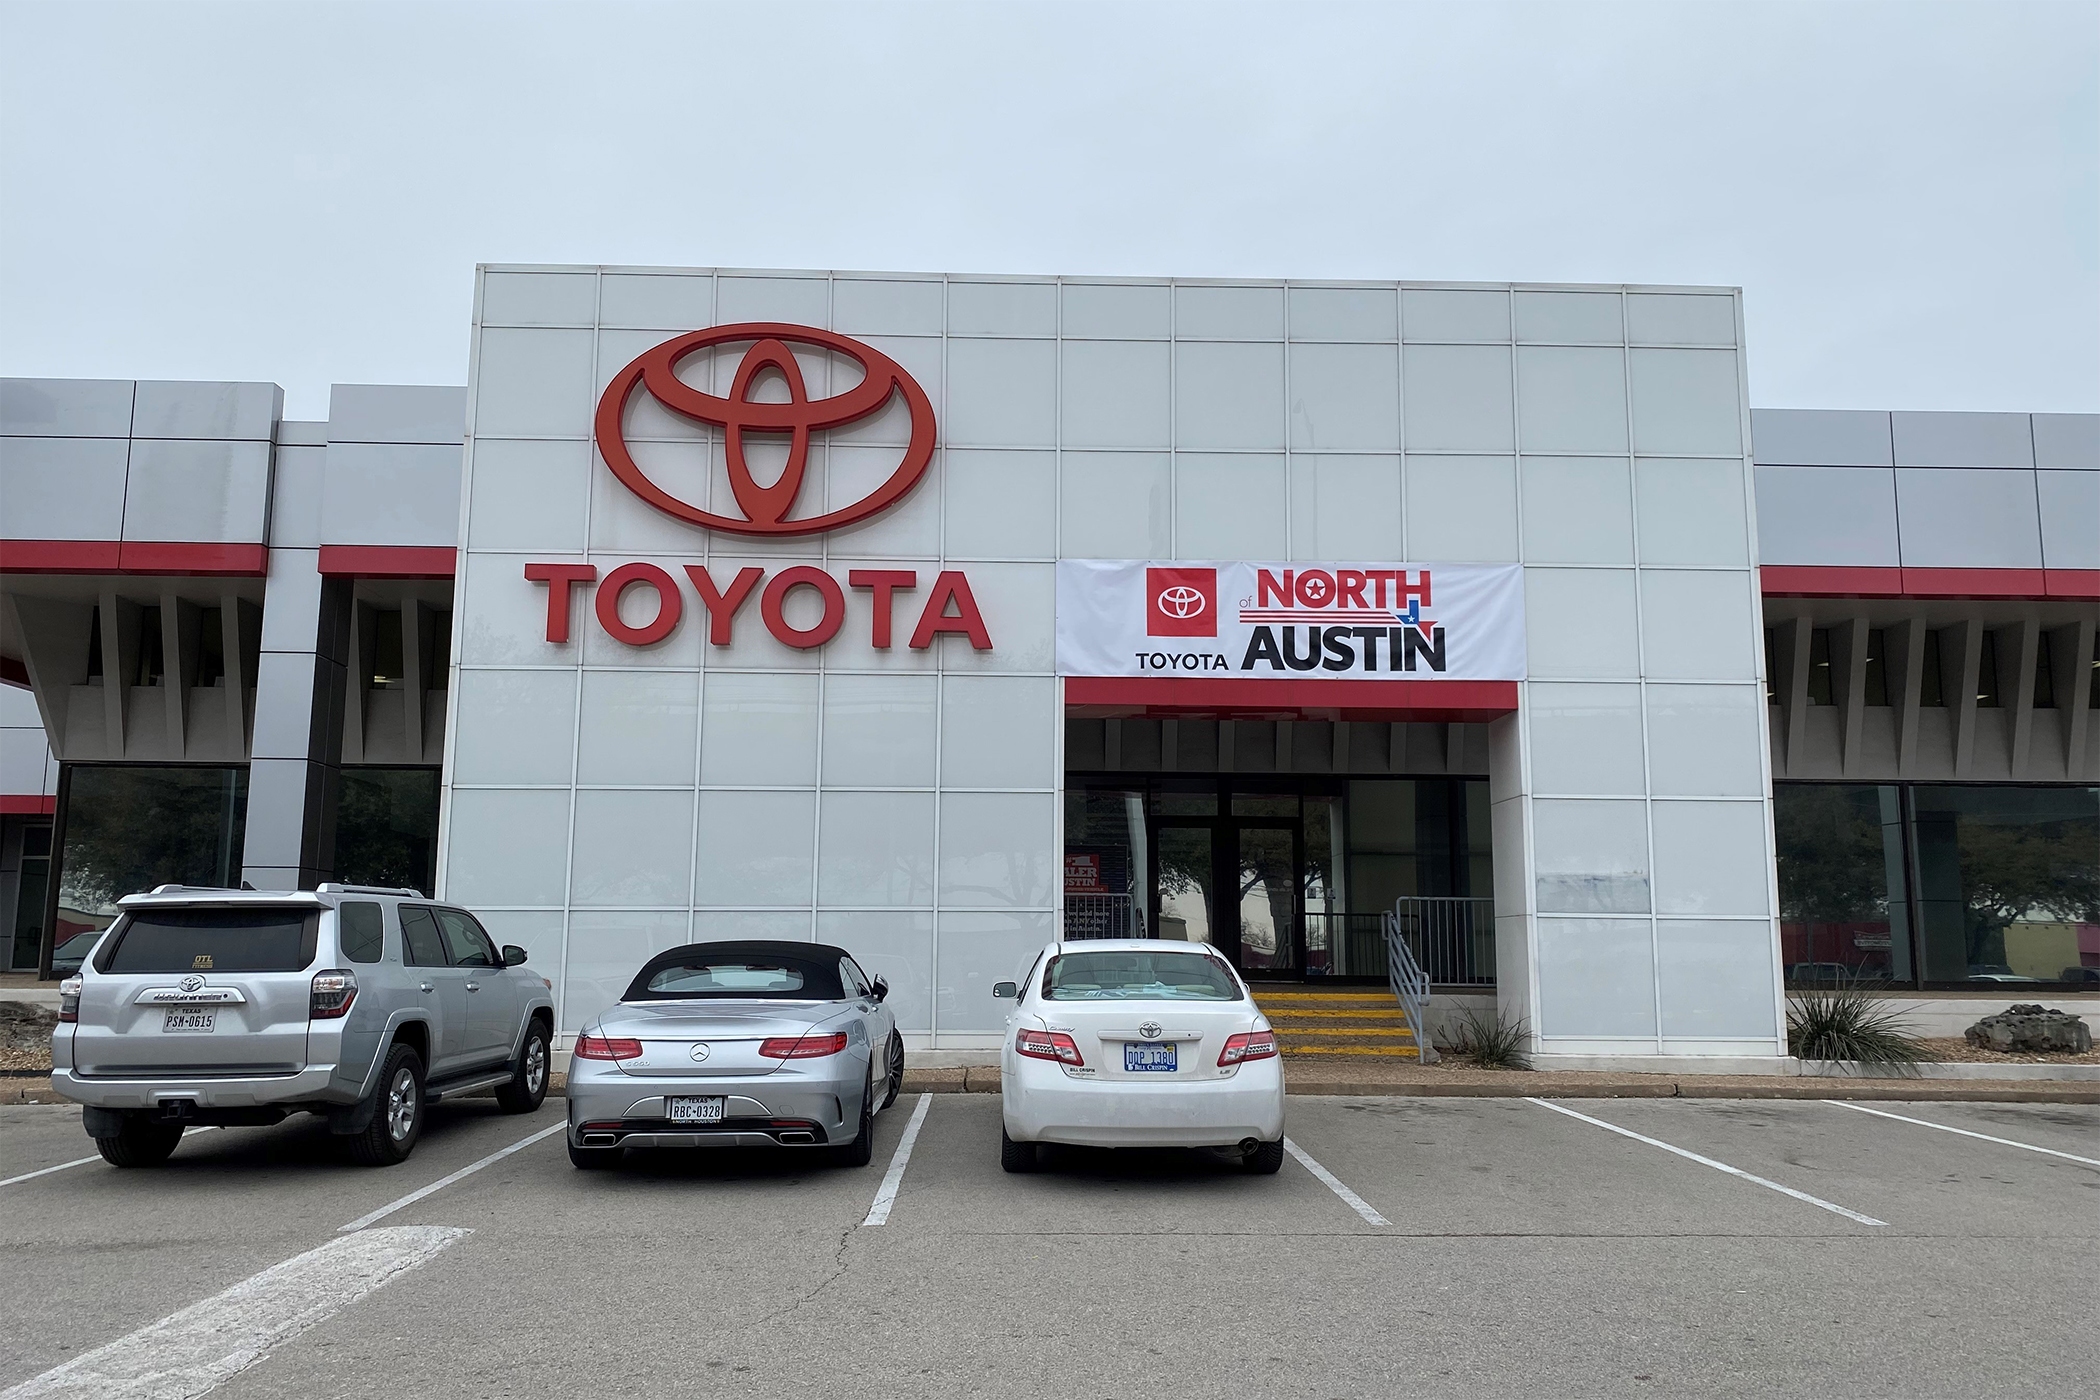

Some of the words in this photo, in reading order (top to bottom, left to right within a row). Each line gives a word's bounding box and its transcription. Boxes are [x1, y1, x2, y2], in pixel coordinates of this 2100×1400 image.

[1239, 595, 1252, 608] of
[1257, 569, 1431, 609] NORTH
[524, 562, 993, 650] TOYOTA
[1136, 652, 1229, 670] TOYOTA
[1241, 625, 1446, 672] AUSTIN
[195, 955, 213, 963] OTL
[1151, 1051, 1174, 1064] 1380
